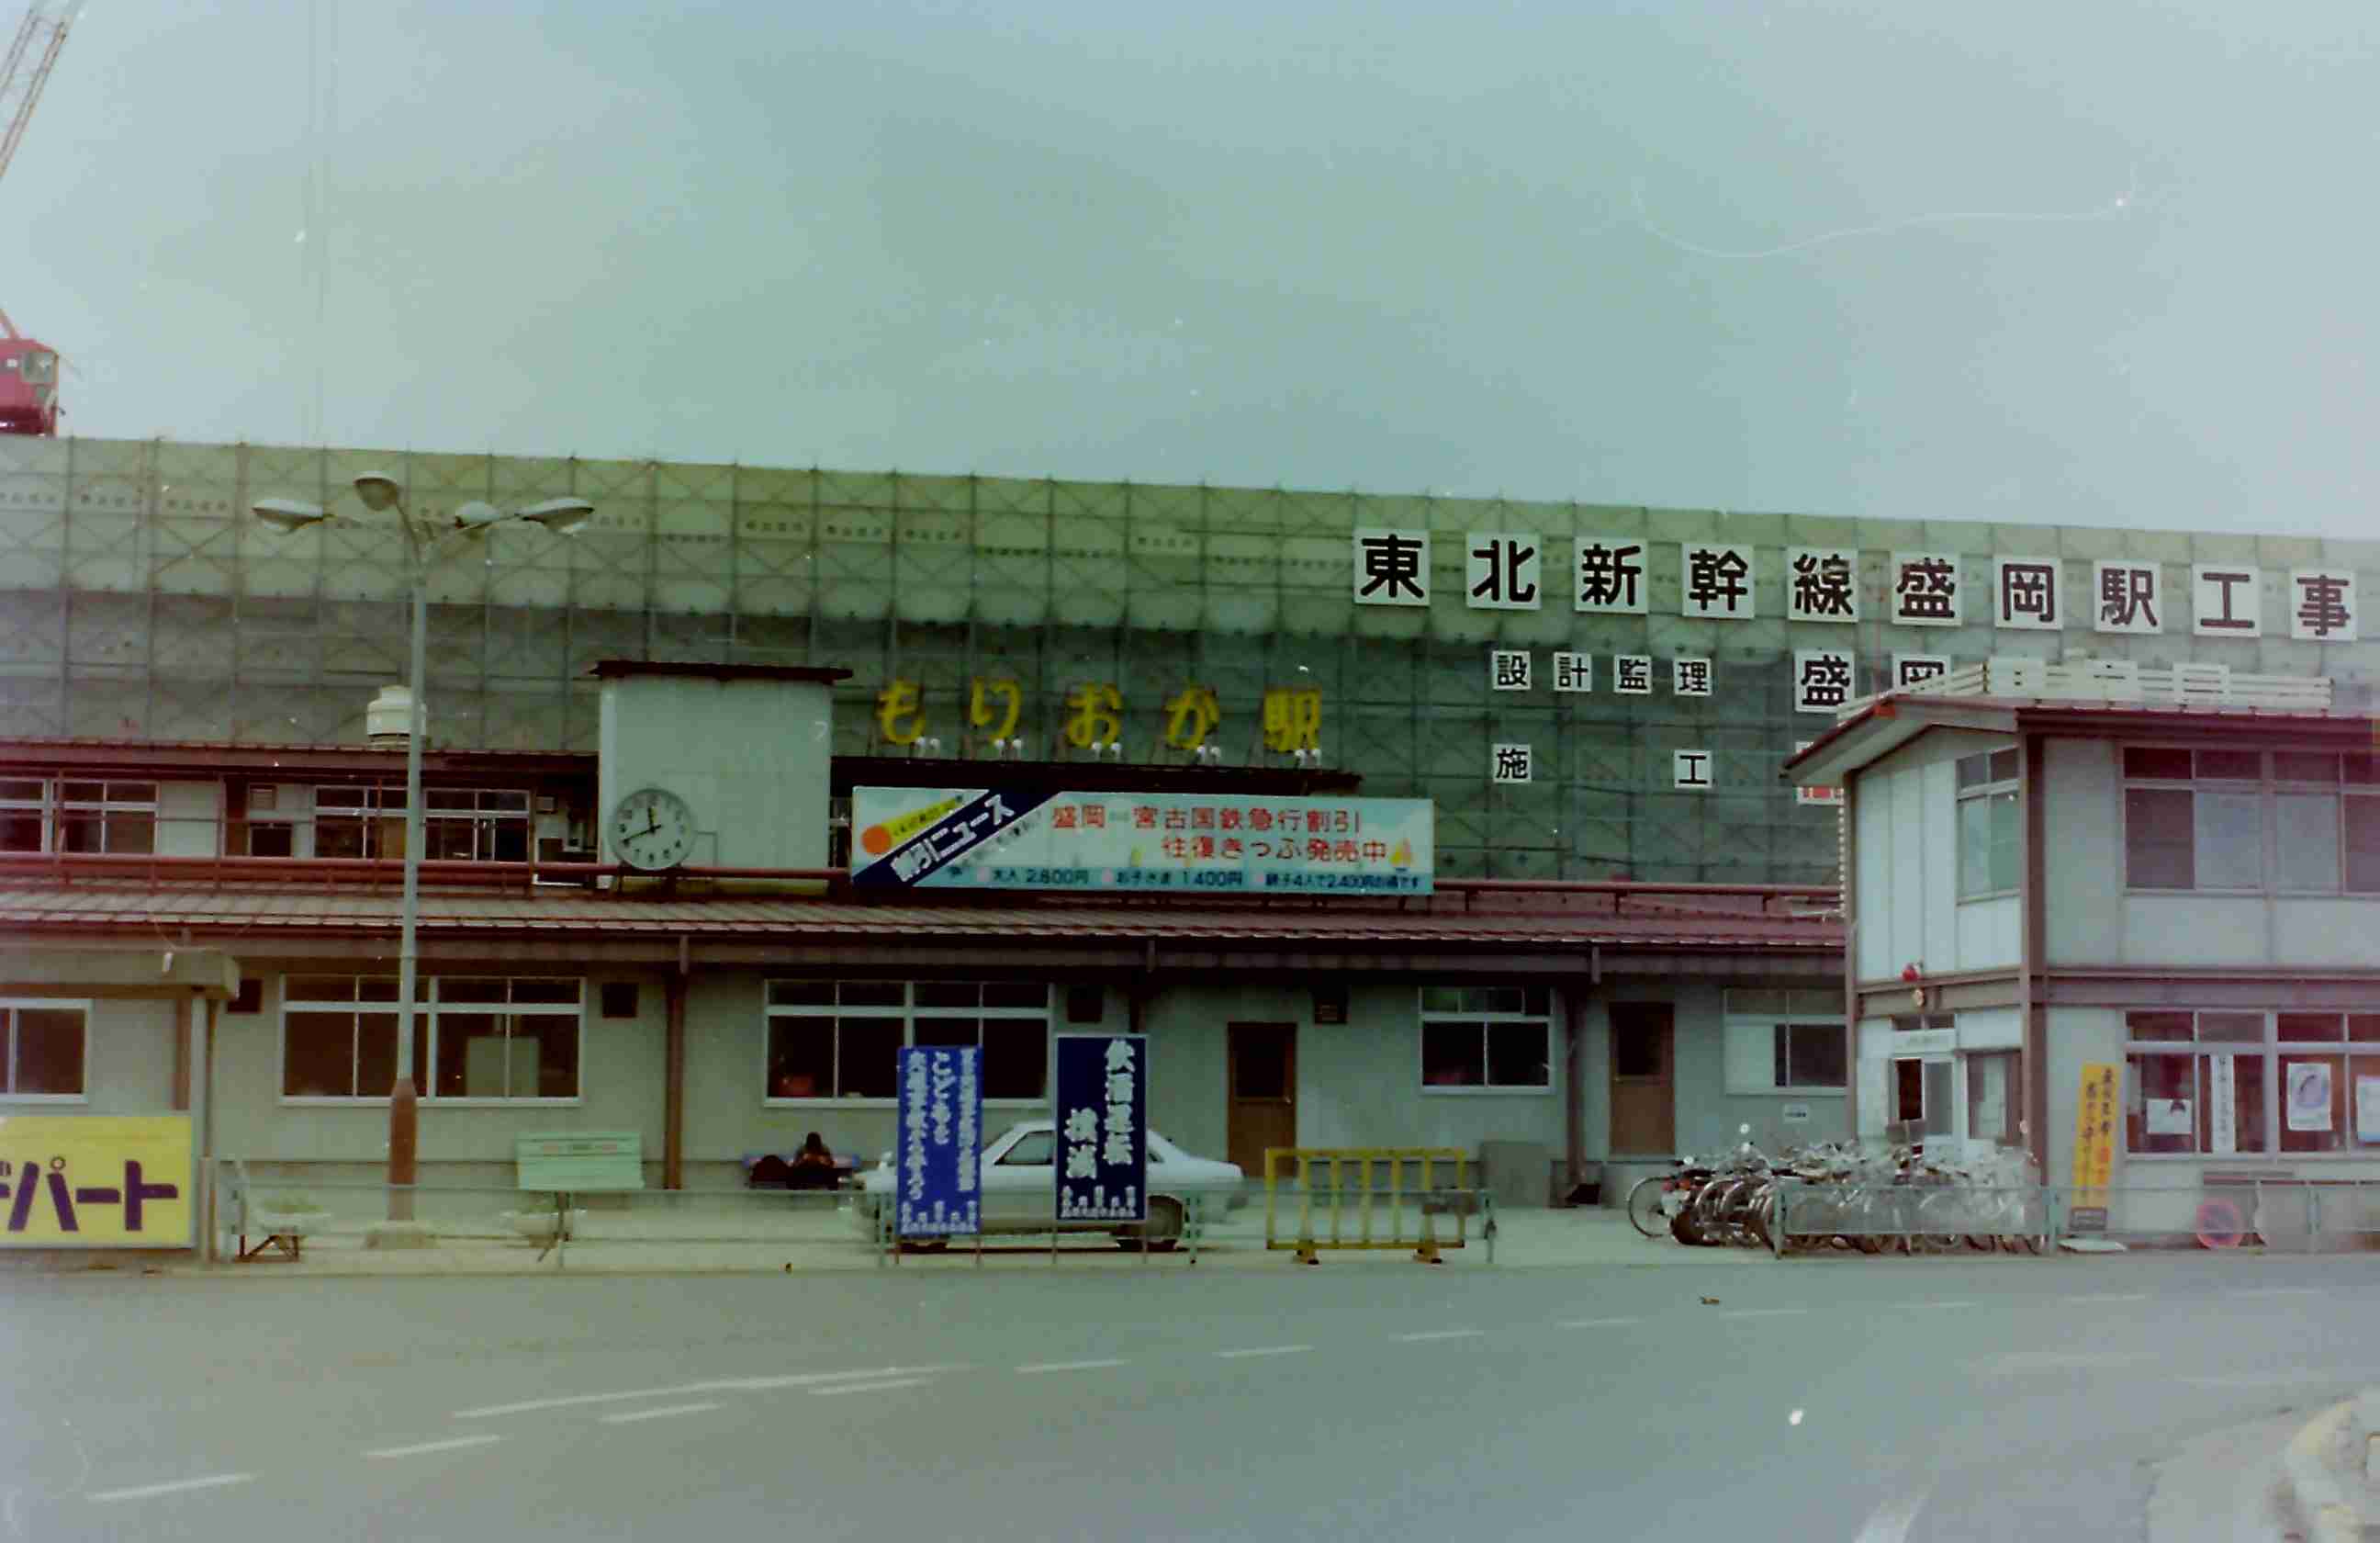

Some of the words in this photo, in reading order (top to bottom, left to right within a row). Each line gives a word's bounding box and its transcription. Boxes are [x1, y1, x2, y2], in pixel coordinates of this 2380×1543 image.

[1360, 532, 2352, 636] 東北新幹線盛岡駅工事
[1496, 653, 1708, 693] 設計監理
[877, 678, 1321, 752] もりおか駅
[1495, 748, 1709, 785] 施工
[0, 1155, 179, 1232] パート
